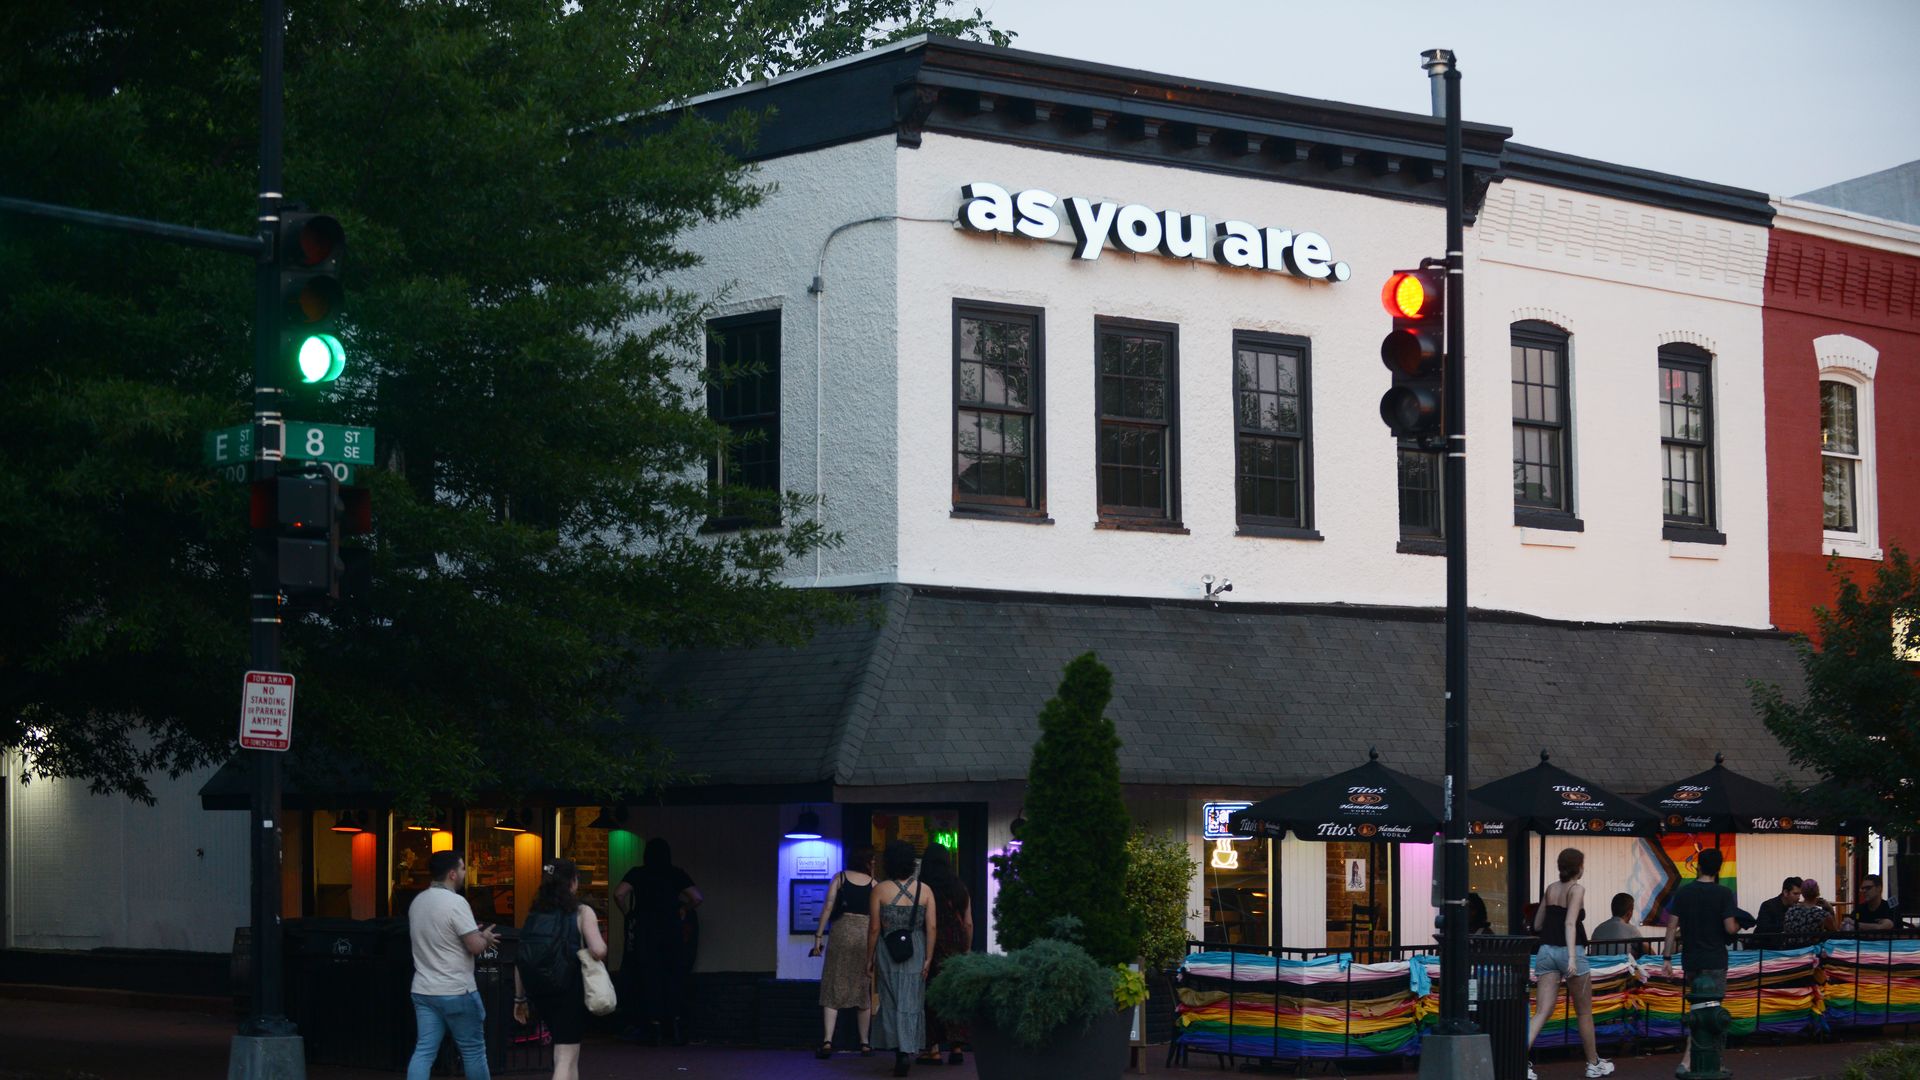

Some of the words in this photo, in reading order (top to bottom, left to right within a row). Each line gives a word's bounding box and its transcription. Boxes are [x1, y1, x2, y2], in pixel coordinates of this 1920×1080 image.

[957, 181, 1060, 240] as
[1063, 197, 1207, 260] you
[1213, 220, 1352, 282] are.
[216, 434, 228, 461] E
[239, 429, 250, 443] ST
[305, 428, 325, 456] 8
[344, 430, 361, 444] ST
[239, 444, 250, 457] SE
[343, 445, 361, 459] SE
[252, 675, 266, 683] TOW
[267, 676, 288, 684] AWAY
[262, 687, 275, 695] NO
[250, 696, 286, 706] STANDING
[255, 706, 287, 717] PARKING
[252, 717, 282, 727] ANYTIME
